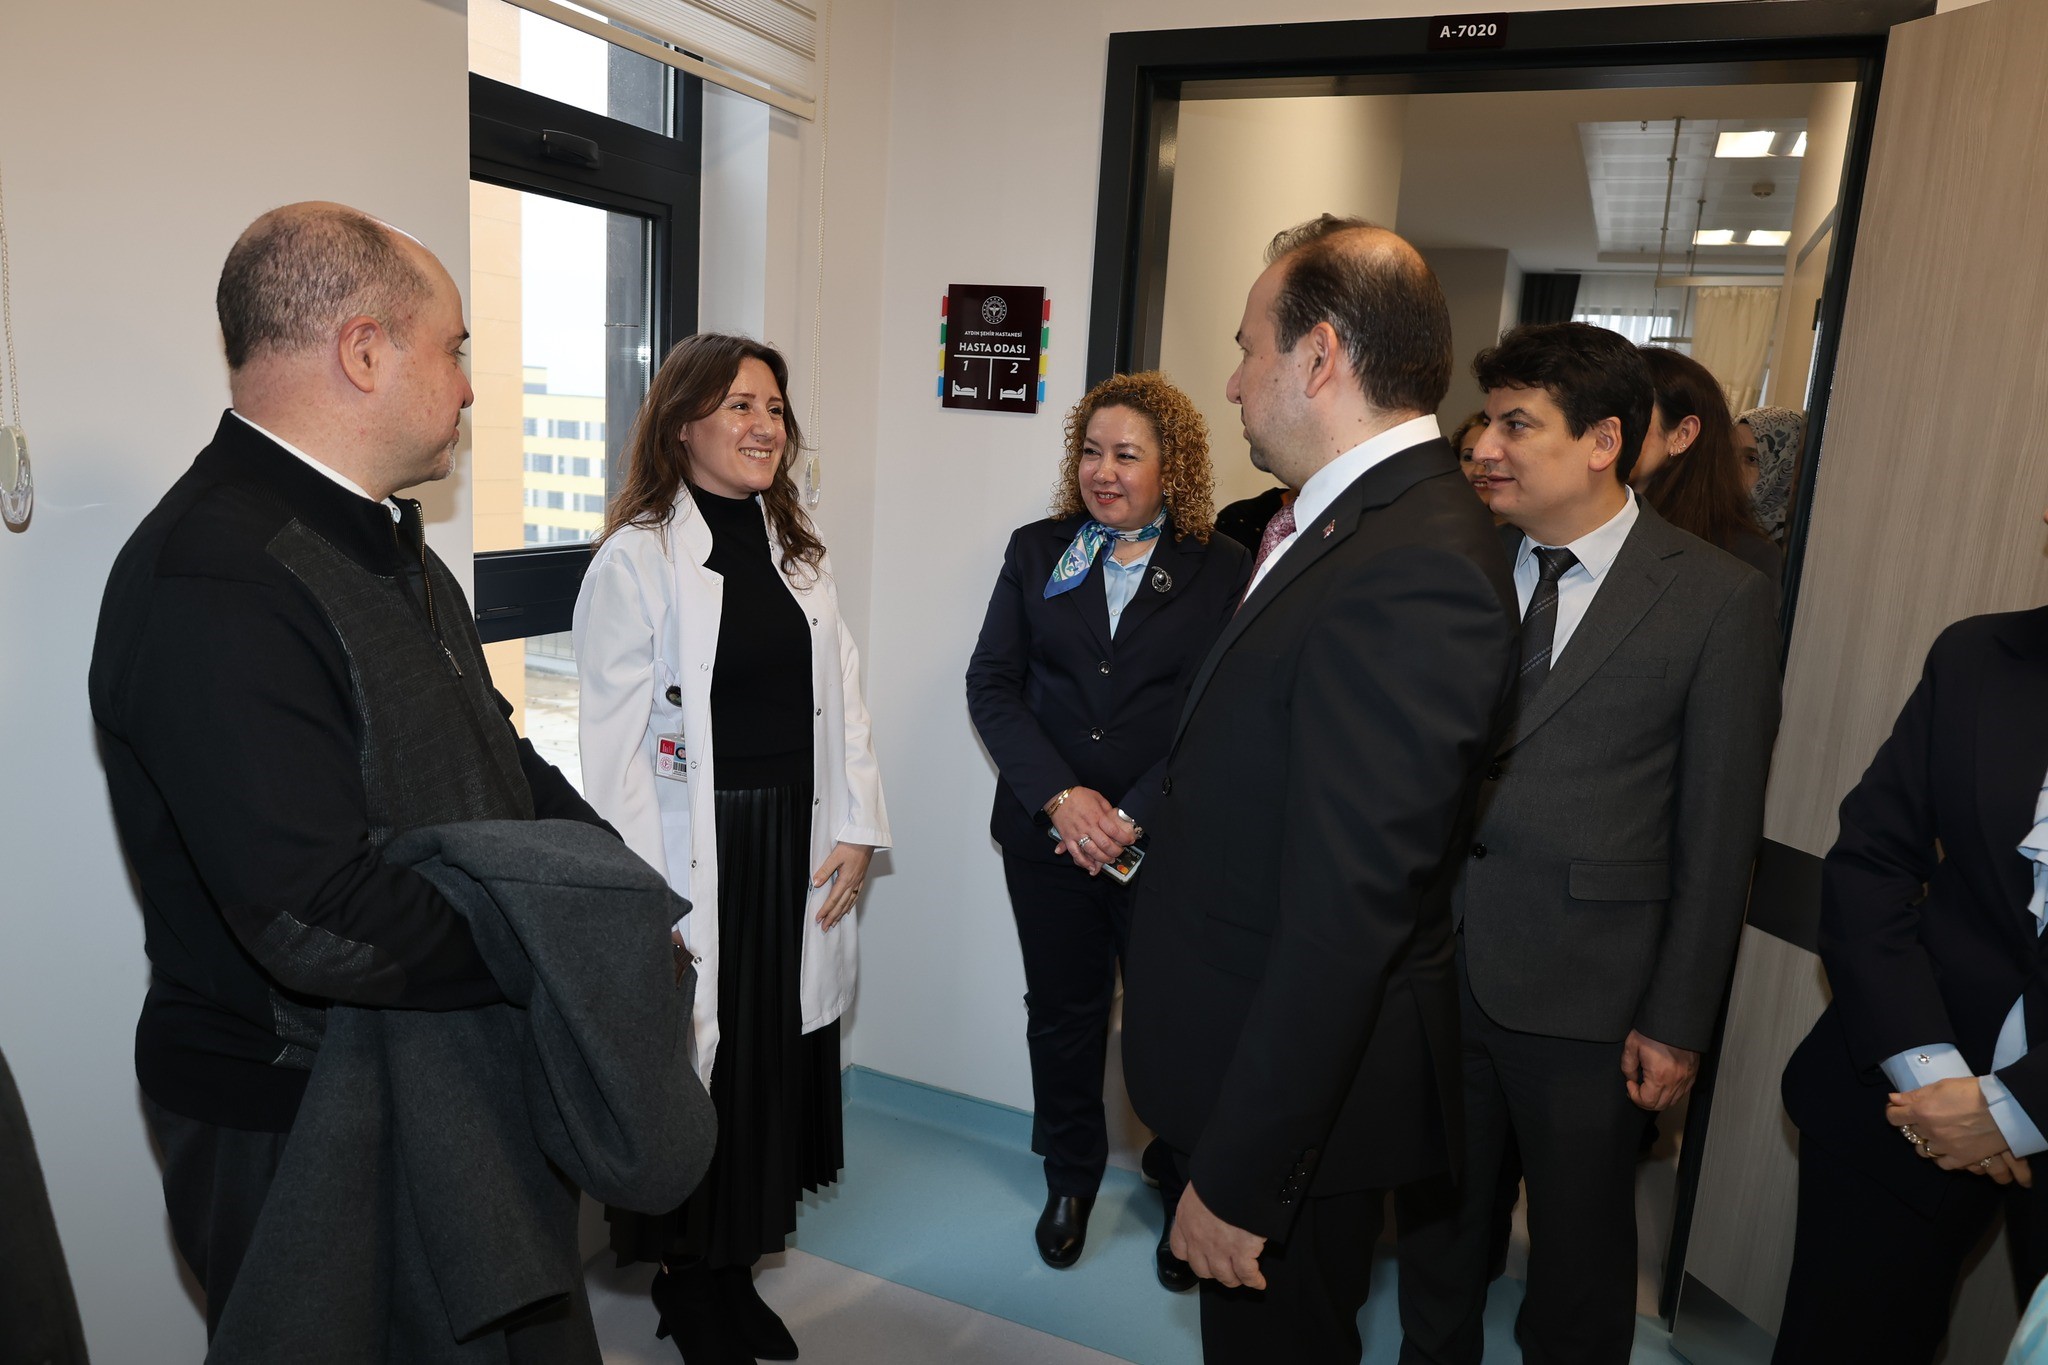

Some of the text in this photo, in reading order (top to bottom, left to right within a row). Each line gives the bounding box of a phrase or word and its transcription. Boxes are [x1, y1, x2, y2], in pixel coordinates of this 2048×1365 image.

[1440, 23, 1497, 38] A-7020
[959, 342, 1026, 354] HASTA ODASI
[963, 360, 1019, 374] 1 2
